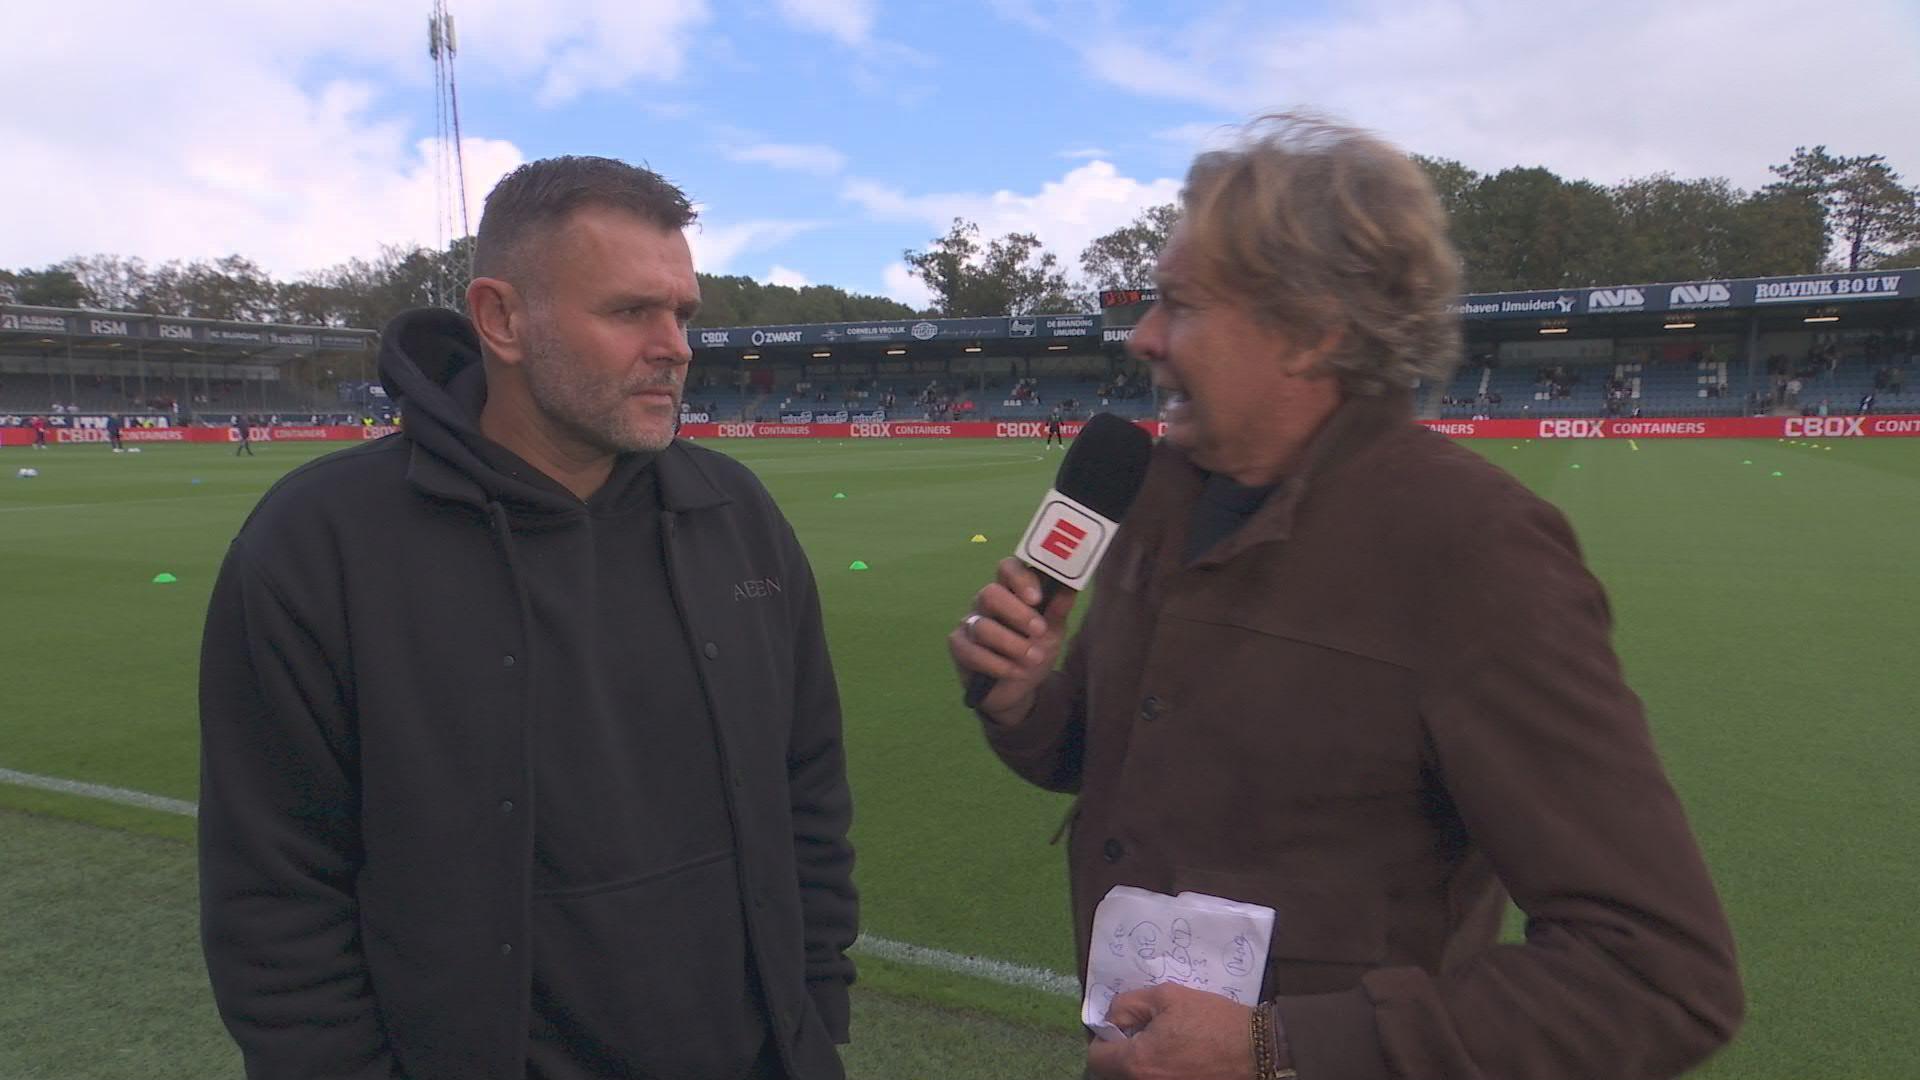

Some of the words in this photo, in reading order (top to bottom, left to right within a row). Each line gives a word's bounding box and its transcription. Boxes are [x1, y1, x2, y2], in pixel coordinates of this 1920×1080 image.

[1755, 280, 1834, 298] ROLVINK
[1836, 275, 1901, 294] BOUW
[90, 320, 127, 335] RSM
[1046, 320, 1057, 328] DE
[1057, 319, 1093, 328] BRANDING
[159, 324, 193, 339] RSM
[701, 332, 730, 344] CBOX
[765, 331, 803, 343] ZWART
[846, 327, 878, 336] CORNELIS
[680, 412, 709, 424] BUKO
[228, 427, 271, 441] COX
[274, 429, 327, 438] CONTAINERS
[718, 424, 755, 437] CBOX
[759, 426, 810, 435] CONTAINERS
[850, 423, 891, 437] CBOX
[895, 425, 951, 435] CONTAINERS
[996, 423, 1041, 437] CBOX
[1539, 420, 1605, 438] CBOX
[1612, 422, 1705, 435] CONTAINERS
[1785, 417, 1866, 437] CBOX
